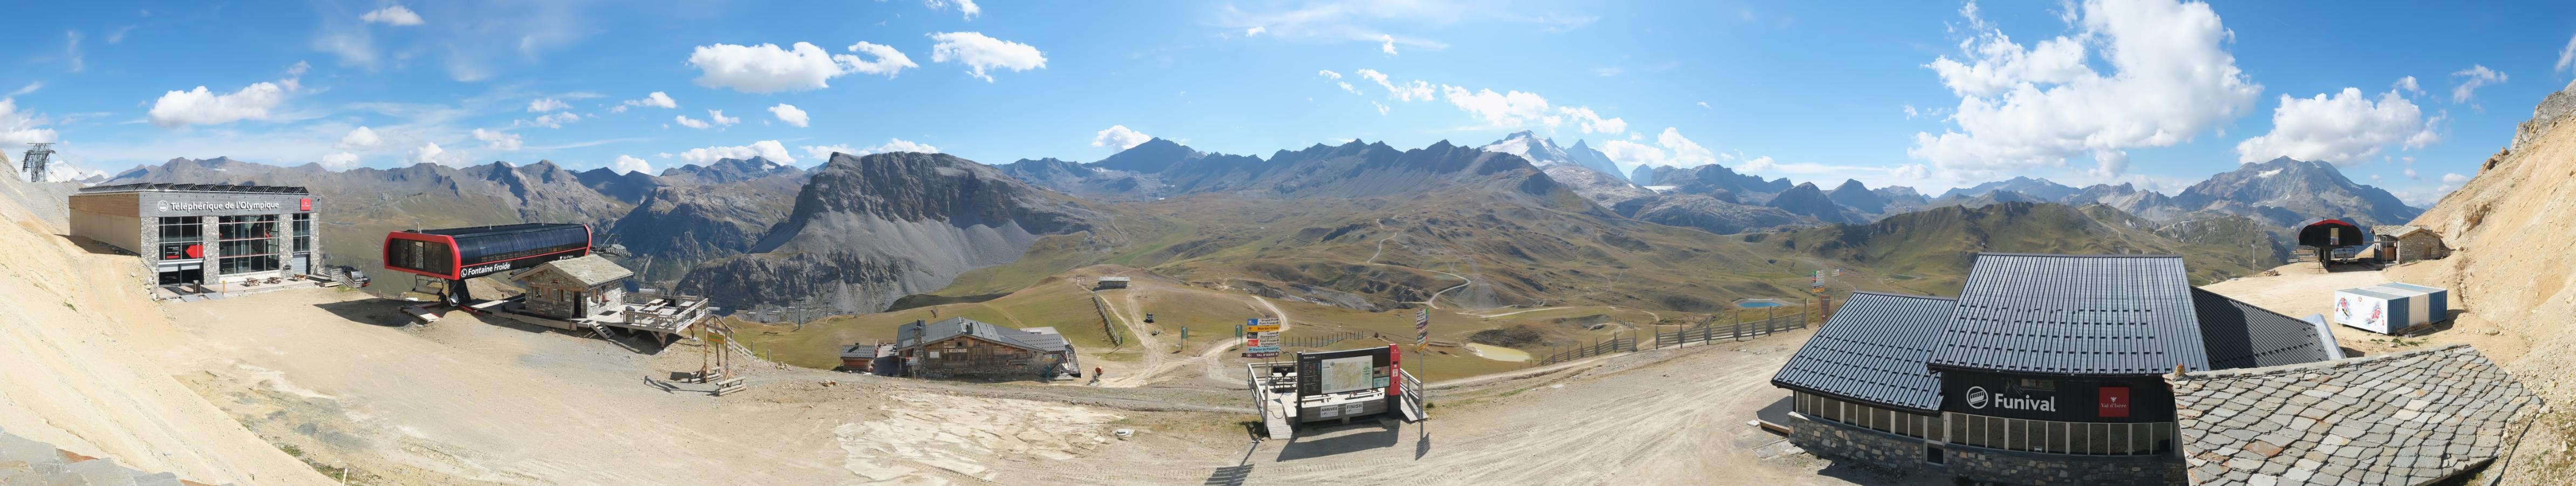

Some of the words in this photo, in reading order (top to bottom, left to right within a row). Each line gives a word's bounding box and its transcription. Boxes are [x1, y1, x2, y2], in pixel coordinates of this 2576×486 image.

[171, 201, 223, 211] Téléphérique
[236, 201, 279, 211] l'Olympique
[468, 265, 493, 276] Fontaine
[494, 262, 510, 271] Froide
[1995, 393, 2056, 412] Funival
